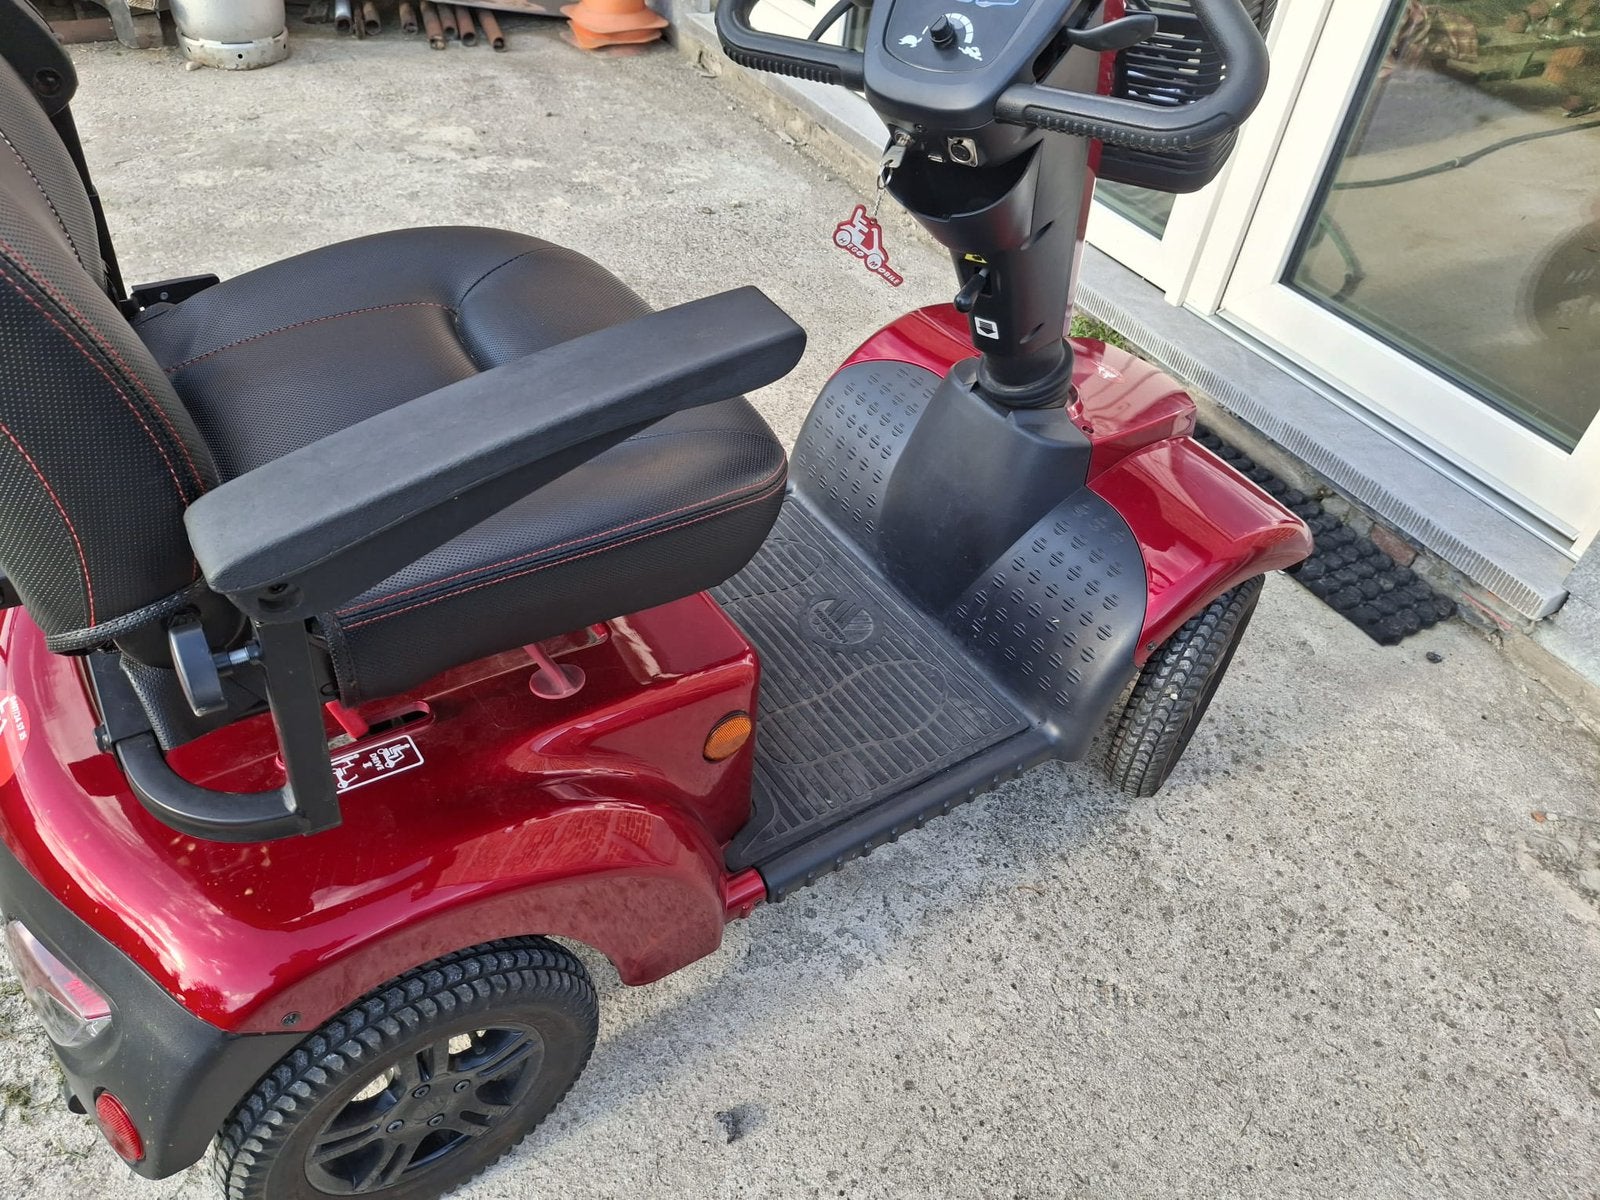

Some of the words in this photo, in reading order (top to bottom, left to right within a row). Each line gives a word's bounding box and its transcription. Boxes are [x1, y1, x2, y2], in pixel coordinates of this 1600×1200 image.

[839, 238, 865, 257] HEGO
[869, 261, 900, 285] MOBILE
[369, 753, 385, 771] DRIVE
